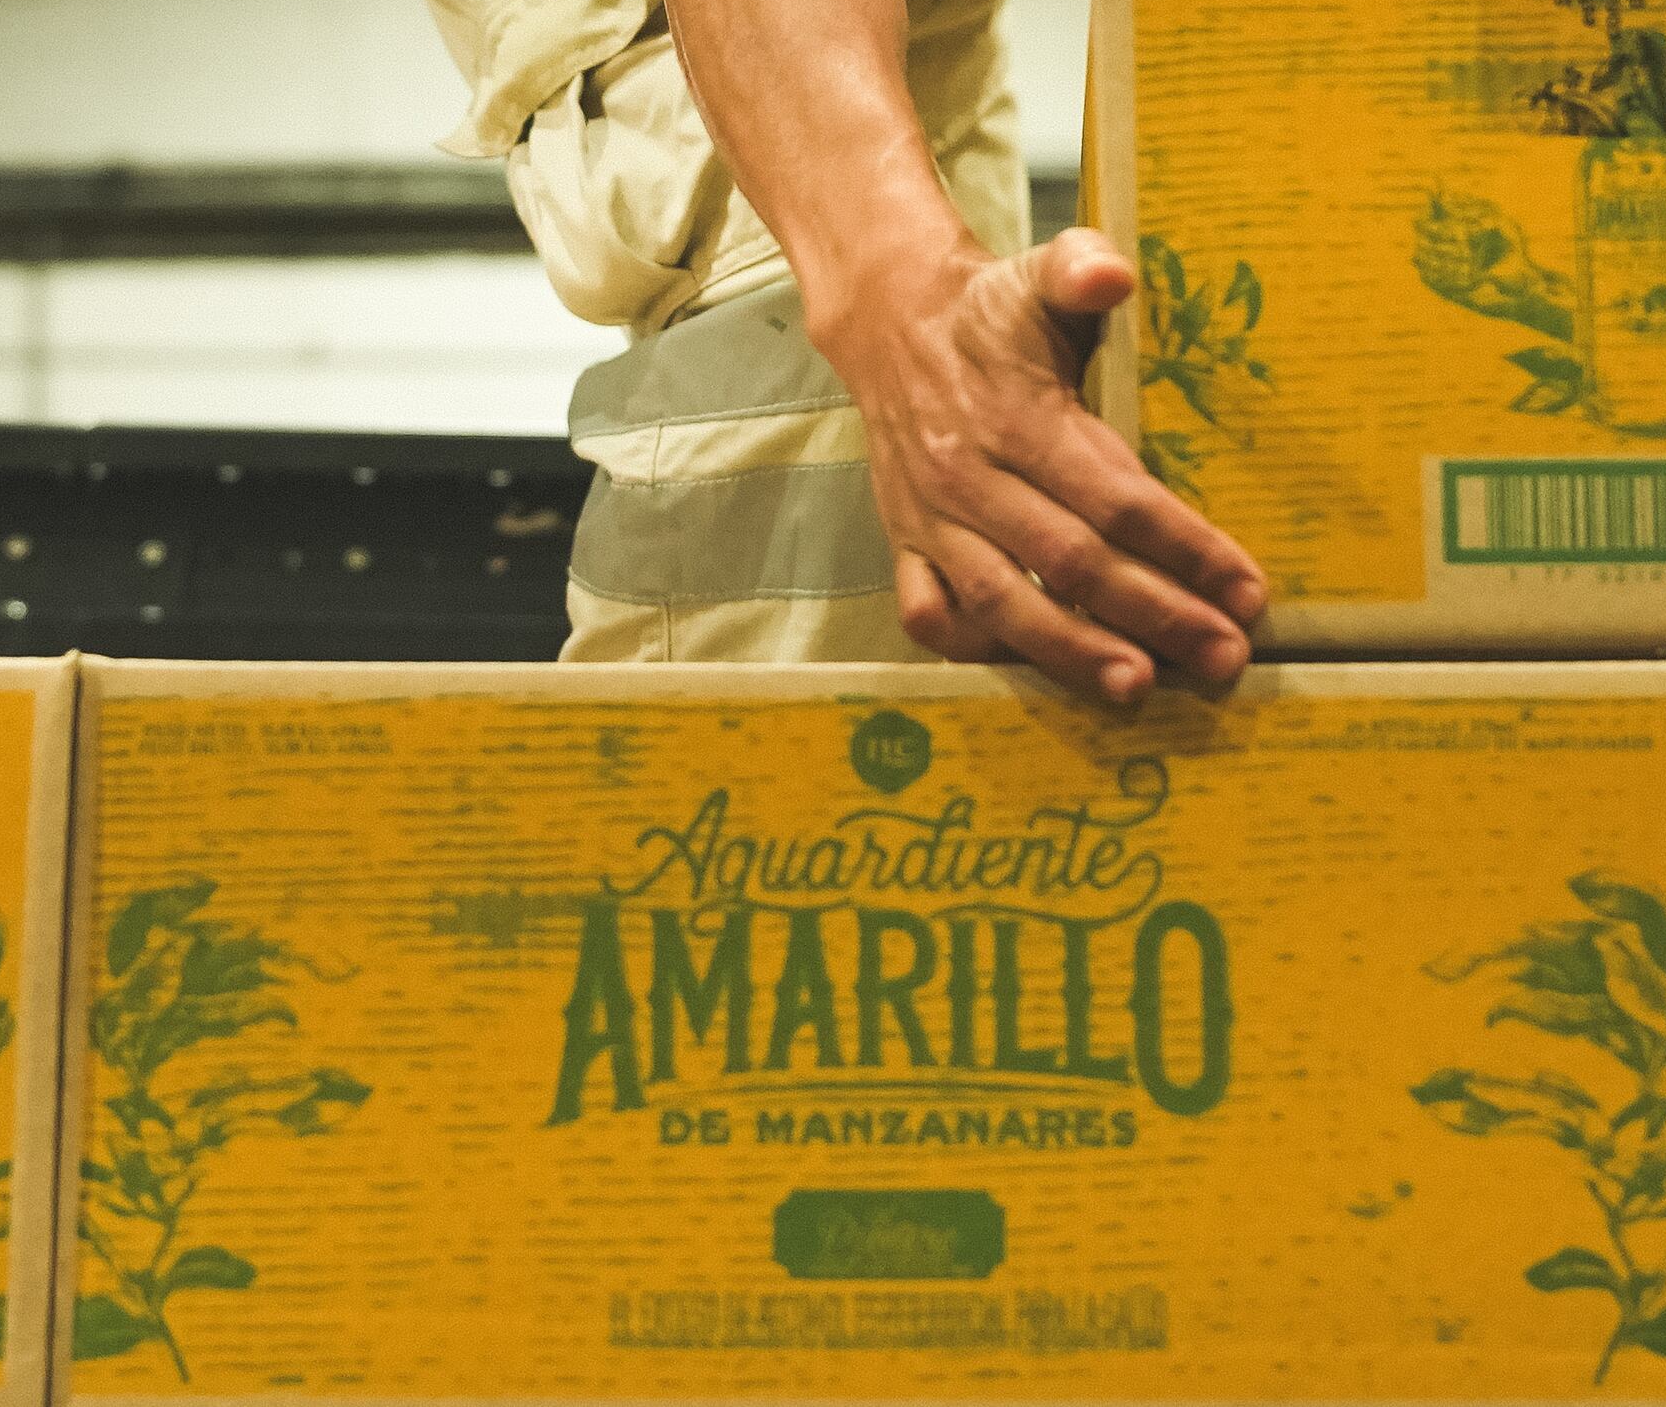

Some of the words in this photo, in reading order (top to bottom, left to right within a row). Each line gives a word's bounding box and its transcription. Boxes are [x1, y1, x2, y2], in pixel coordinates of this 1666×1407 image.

[599, 753, 1169, 939] Aguardiente
[544, 899, 1234, 1129] AMARILLO
[658, 1107, 731, 1147] DE
[755, 1107, 1139, 1151] MANZANARES
